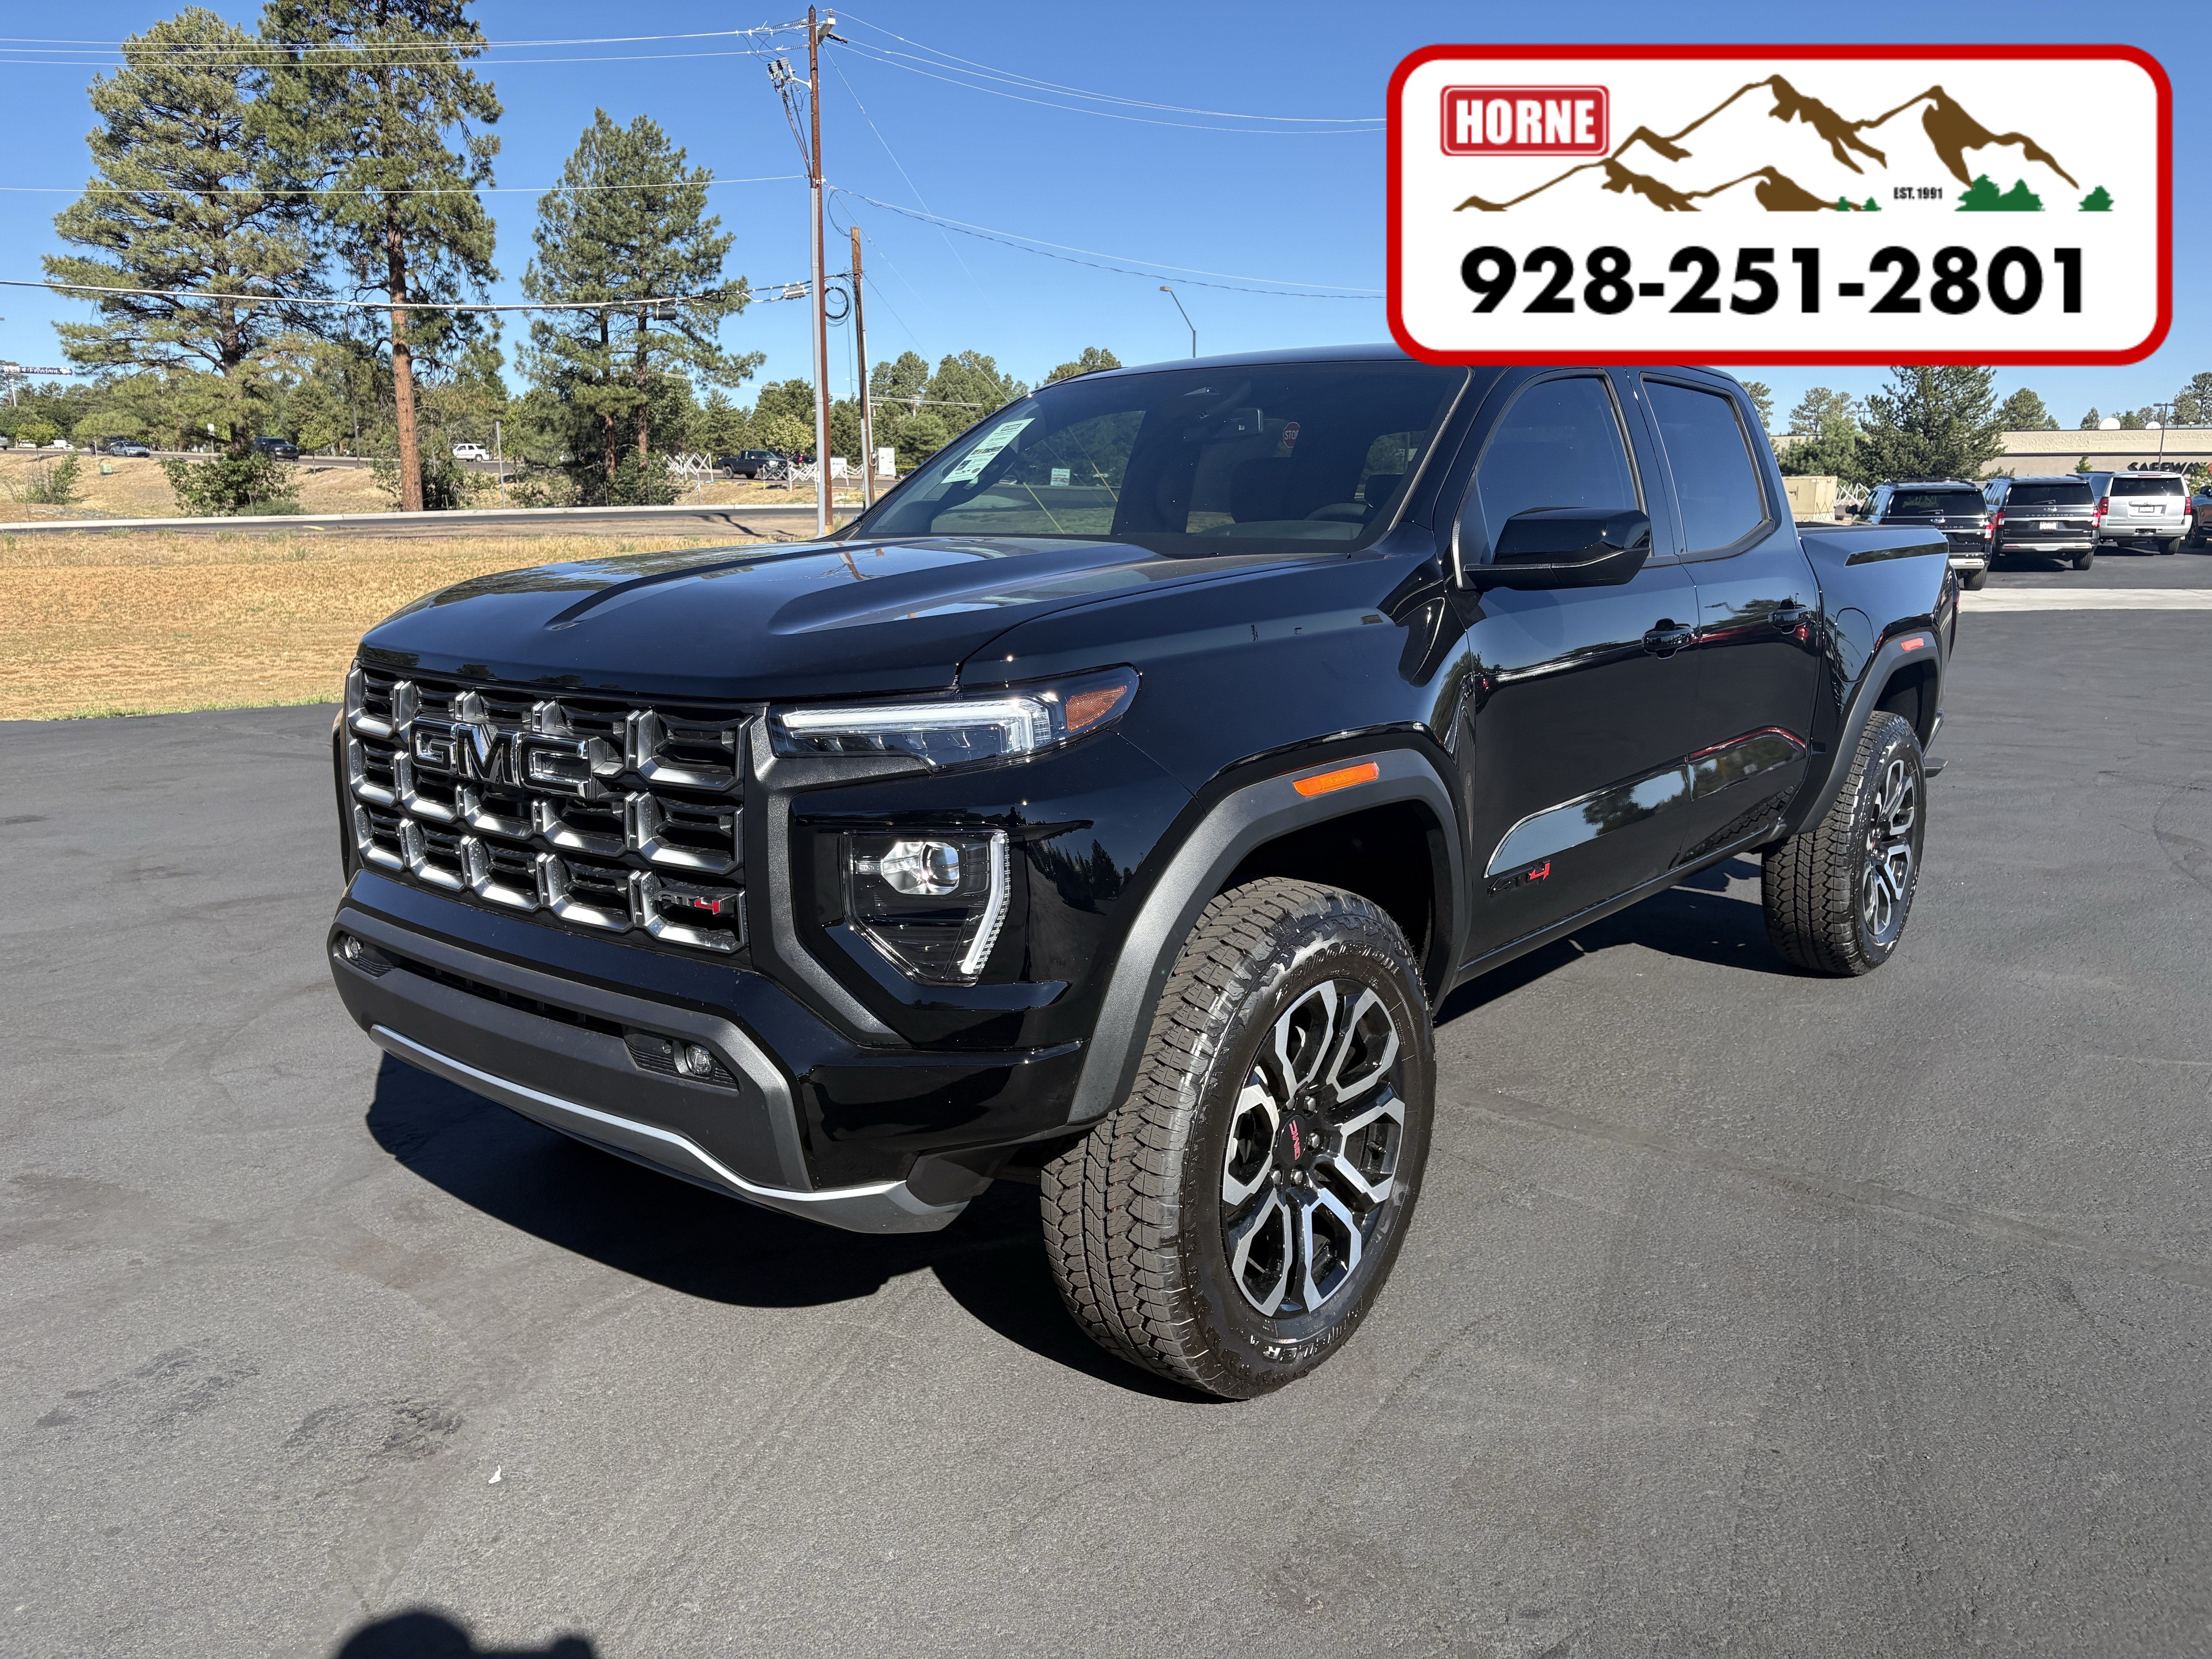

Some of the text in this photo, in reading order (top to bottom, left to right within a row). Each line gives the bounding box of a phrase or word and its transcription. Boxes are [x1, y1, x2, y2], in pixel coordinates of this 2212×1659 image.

[409, 715, 591, 799] GMC
[654, 890, 721, 915] AT4
[1289, 1120, 1300, 1160] GMC
